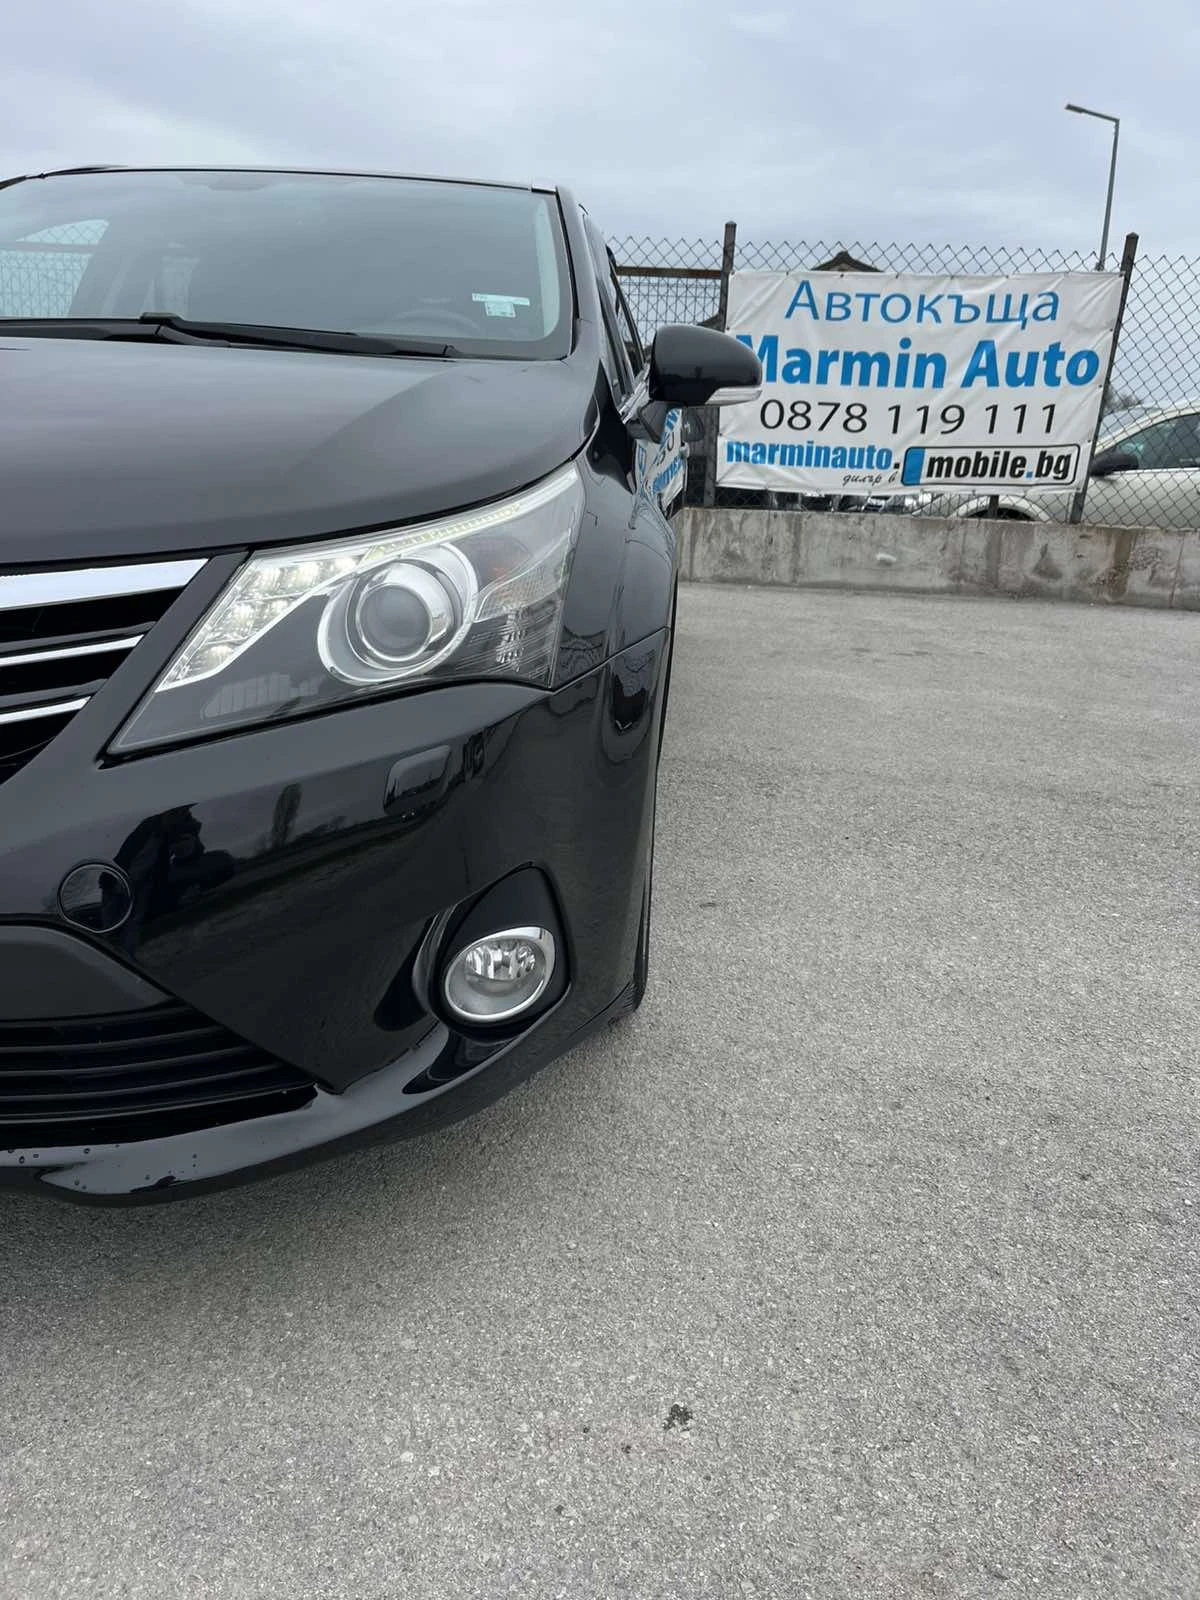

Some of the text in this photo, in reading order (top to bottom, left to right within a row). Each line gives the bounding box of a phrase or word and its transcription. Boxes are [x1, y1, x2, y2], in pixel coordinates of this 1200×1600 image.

[785, 280, 1060, 330] Автокъща
[960, 339, 1100, 388] Auto
[760, 399, 1056, 435] 0878 119 111
[926, 451, 1073, 481] mobile.bg
